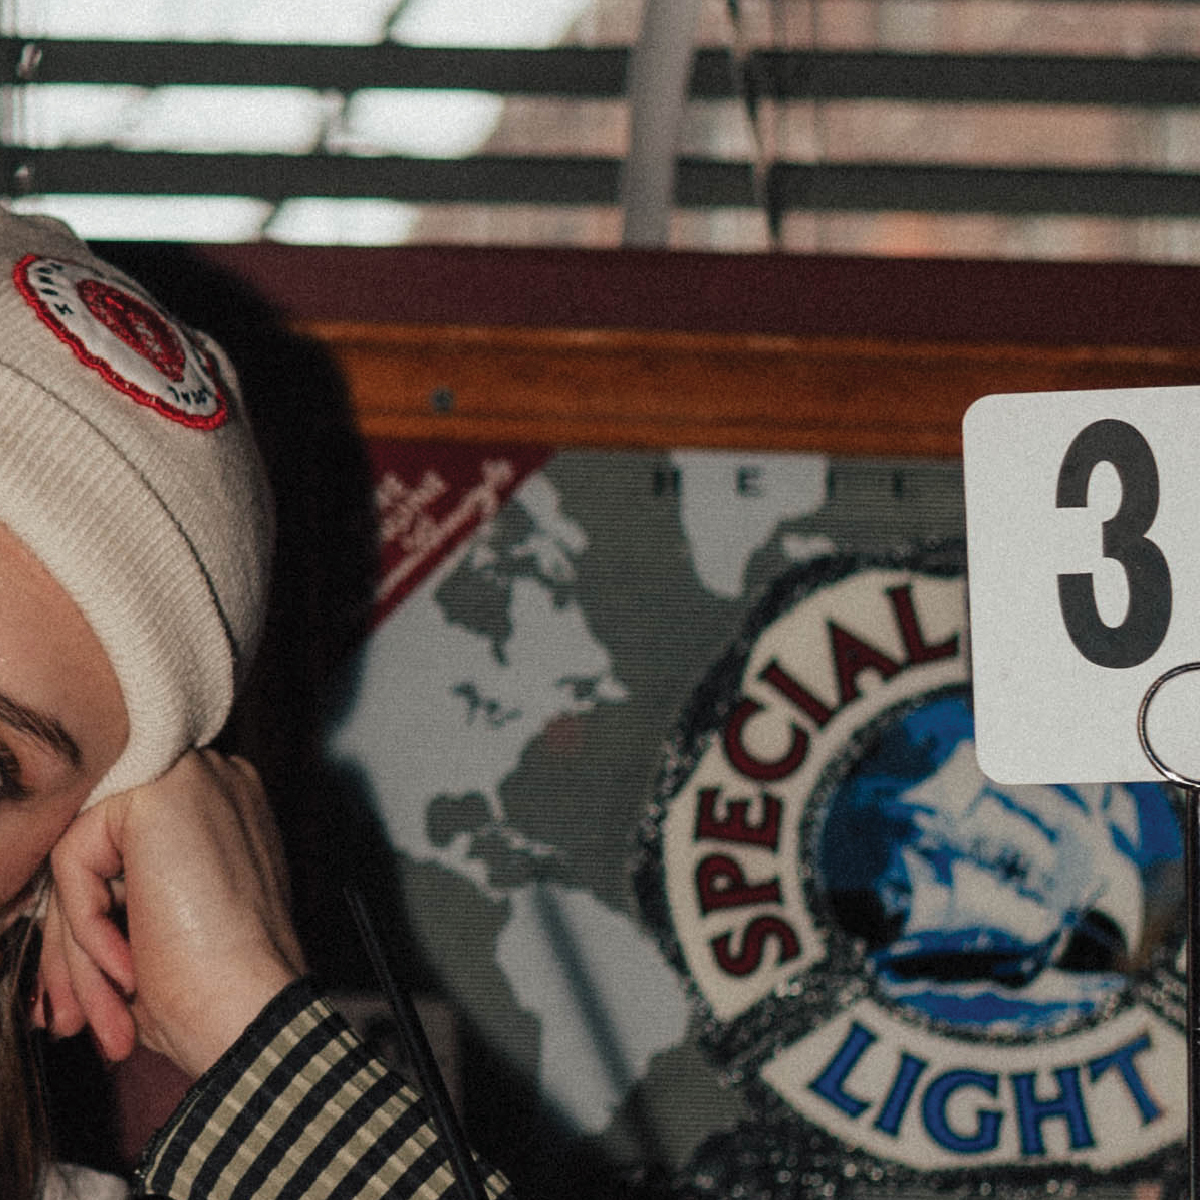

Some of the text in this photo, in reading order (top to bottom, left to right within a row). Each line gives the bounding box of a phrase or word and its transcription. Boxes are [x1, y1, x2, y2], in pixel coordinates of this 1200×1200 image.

[1055, 418, 1173, 669] 3
[695, 582, 961, 977] SPECIAL
[808, 1021, 1163, 1157] LIGHT
